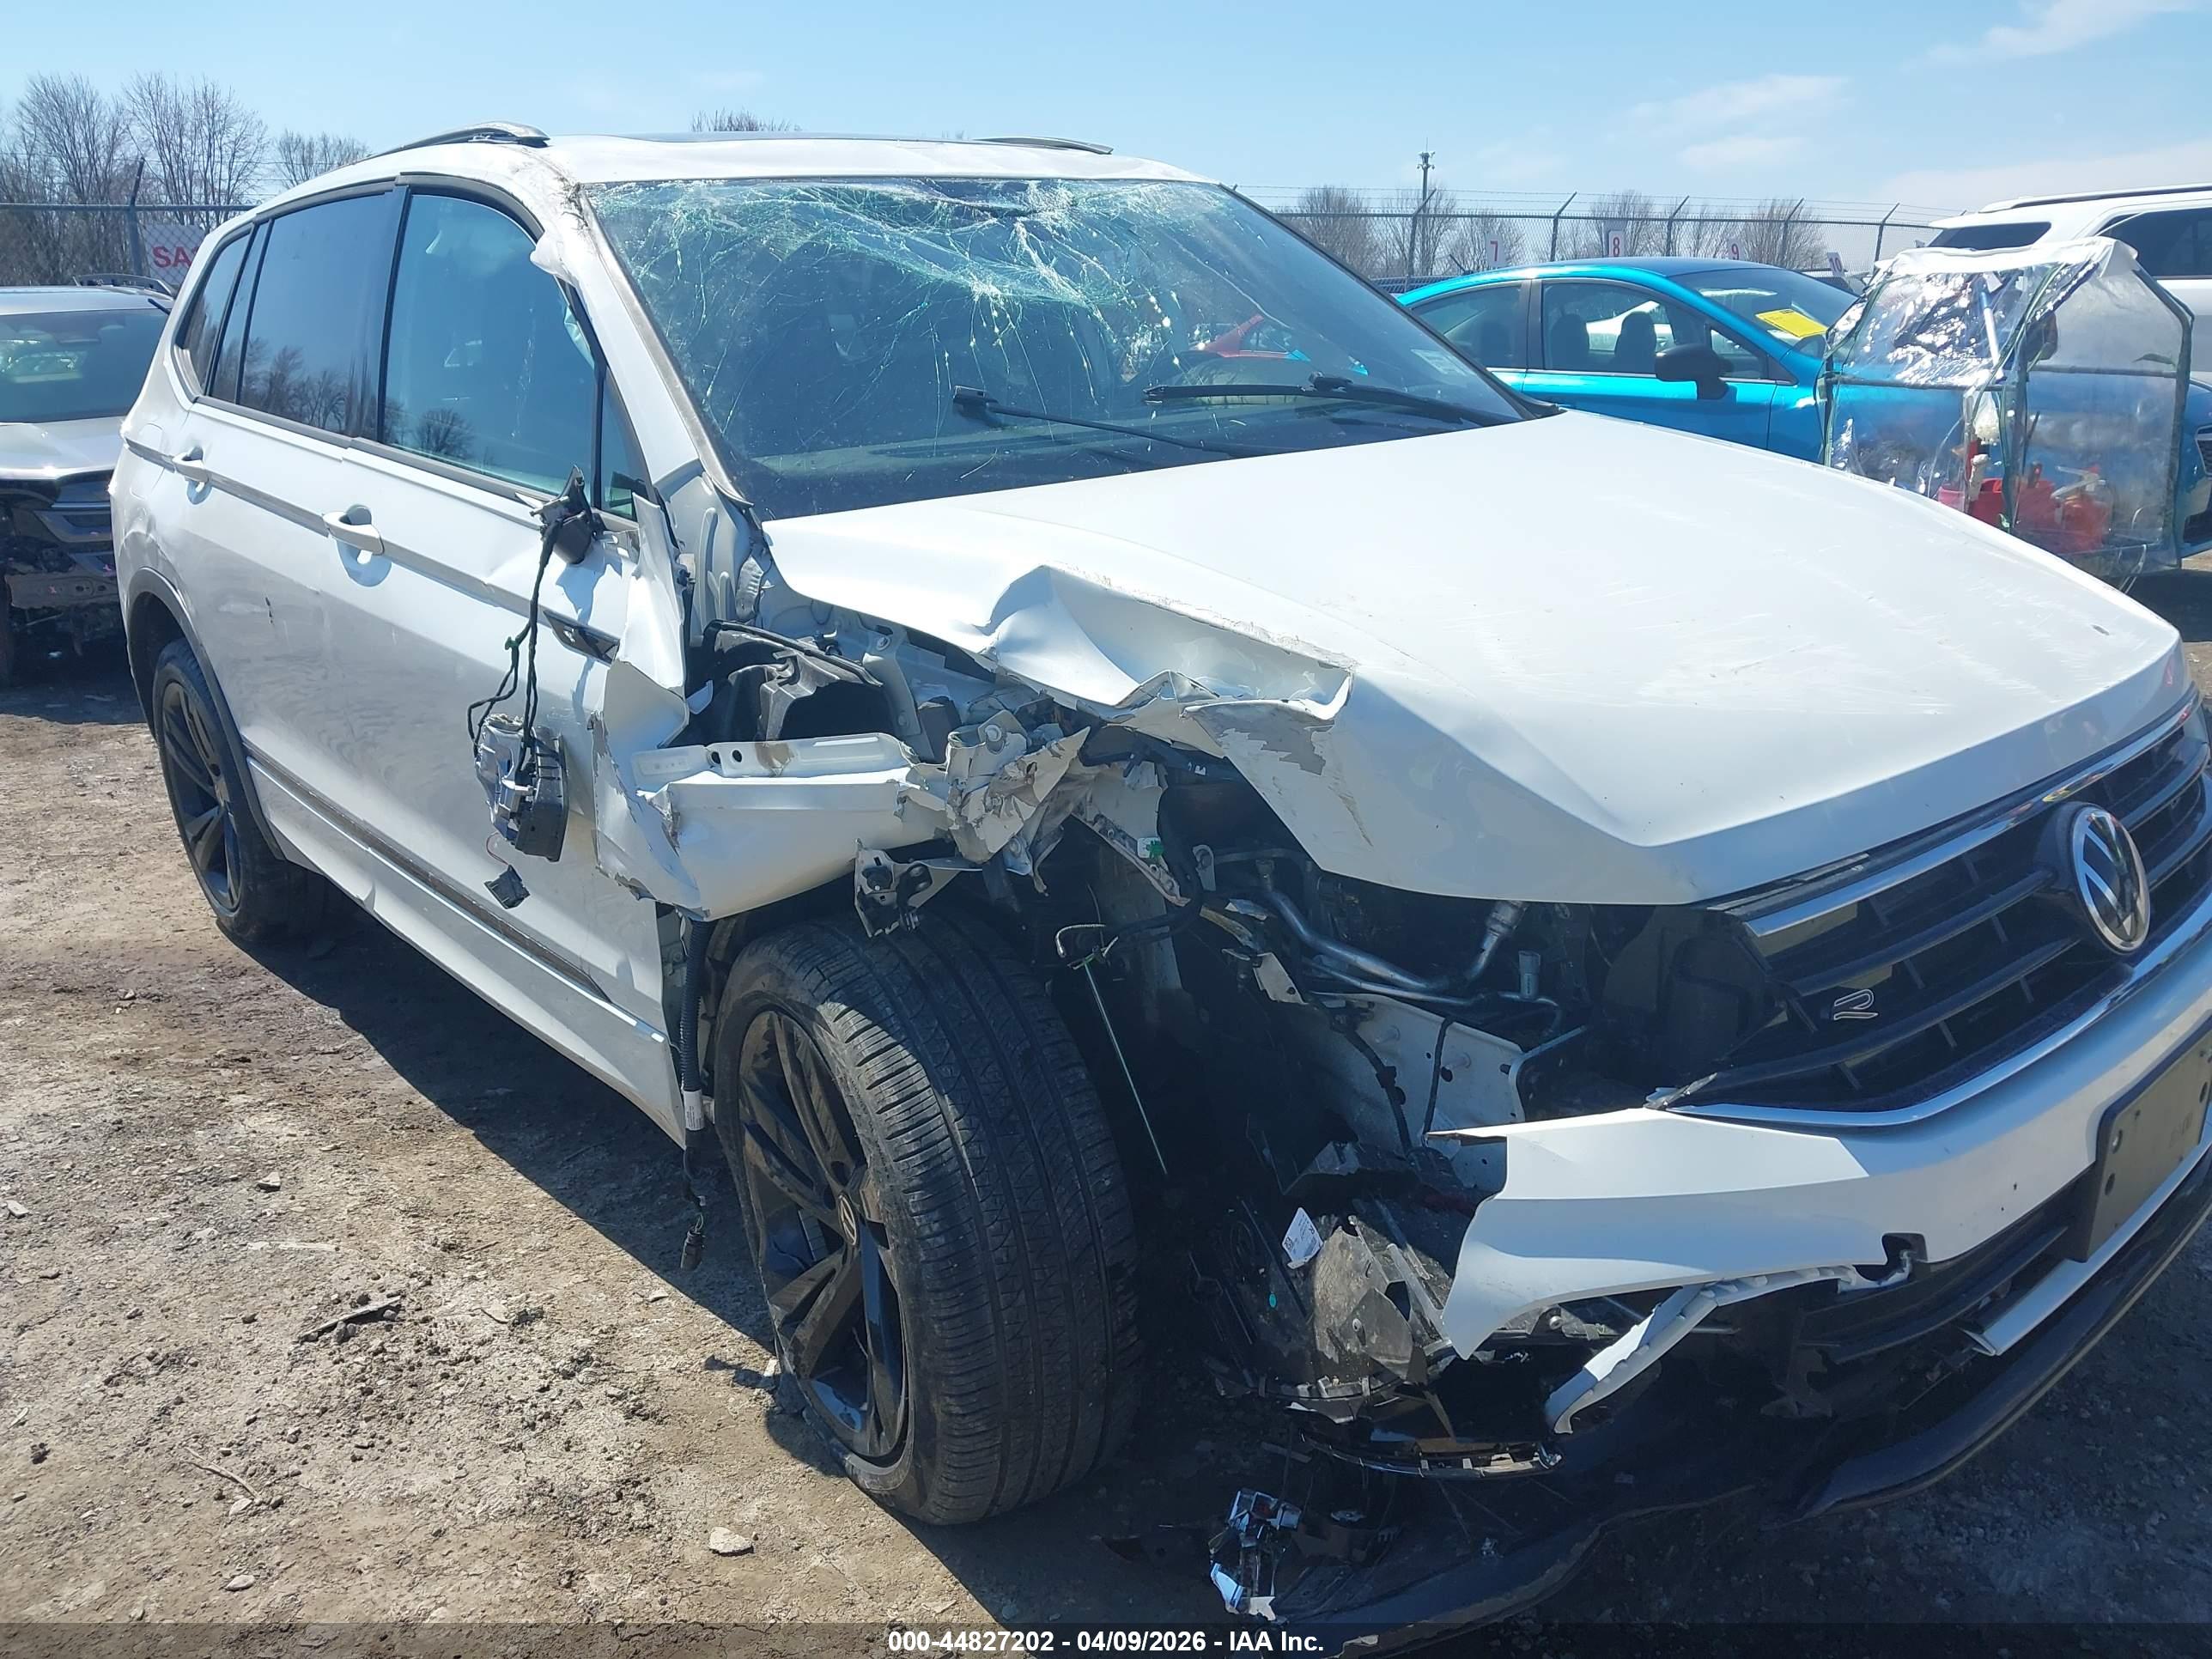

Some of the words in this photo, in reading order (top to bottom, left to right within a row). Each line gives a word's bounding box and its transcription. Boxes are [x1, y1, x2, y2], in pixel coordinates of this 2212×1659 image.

[152, 246, 199, 268] SA
[1490, 240, 1498, 261] 7
[1613, 236, 1620, 257] 8
[1731, 243, 1740, 260] 9
[1828, 257, 1843, 273] 10
